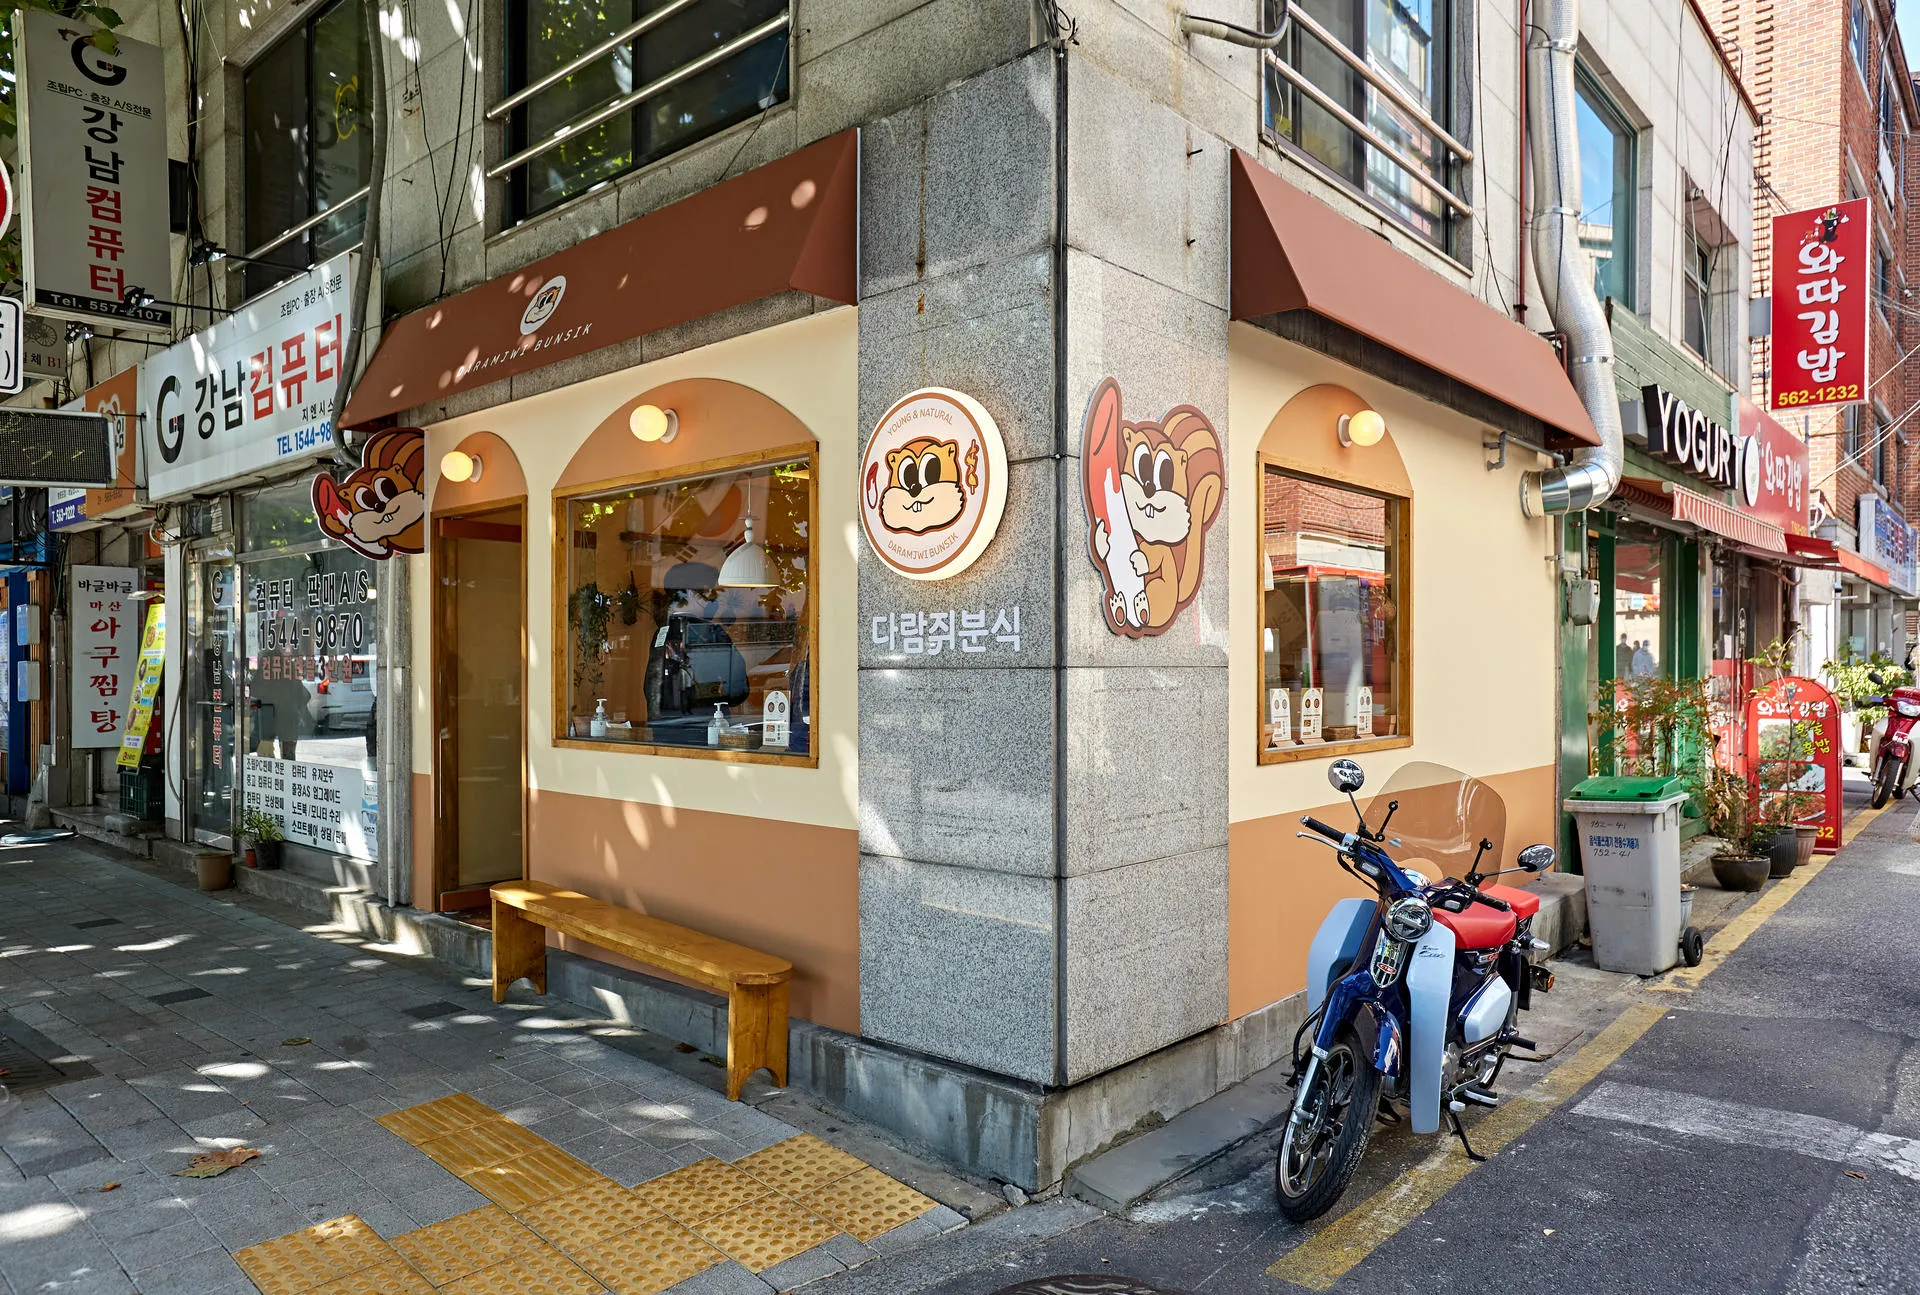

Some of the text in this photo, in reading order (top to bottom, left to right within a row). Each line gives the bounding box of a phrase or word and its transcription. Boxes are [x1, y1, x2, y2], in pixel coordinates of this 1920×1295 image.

[81, 105, 126, 303] 강남컴퓨터
[50, 293, 82, 308] Tel.
[1796, 241, 1847, 383] 와따김밥
[456, 322, 593, 378] DARAMJWI BUNSIK
[194, 313, 343, 440] 강남컴퓨터
[1778, 384, 1859, 407] 562-1232
[277, 420, 332, 456] TEL 1544-98
[887, 407, 954, 437] YOUNG & NATURAL
[1656, 384, 1743, 490] YOGURT
[888, 532, 959, 560] DARAMJWI BUNSIK
[78, 579, 134, 594] 바글바글
[256, 578, 294, 612] 컴퓨터
[259, 611, 363, 651] 1544-9870
[872, 606, 1021, 655] 다람쥐분식
[311, 767, 334, 783] 유지보수
[312, 785, 341, 804] 업그레이드
